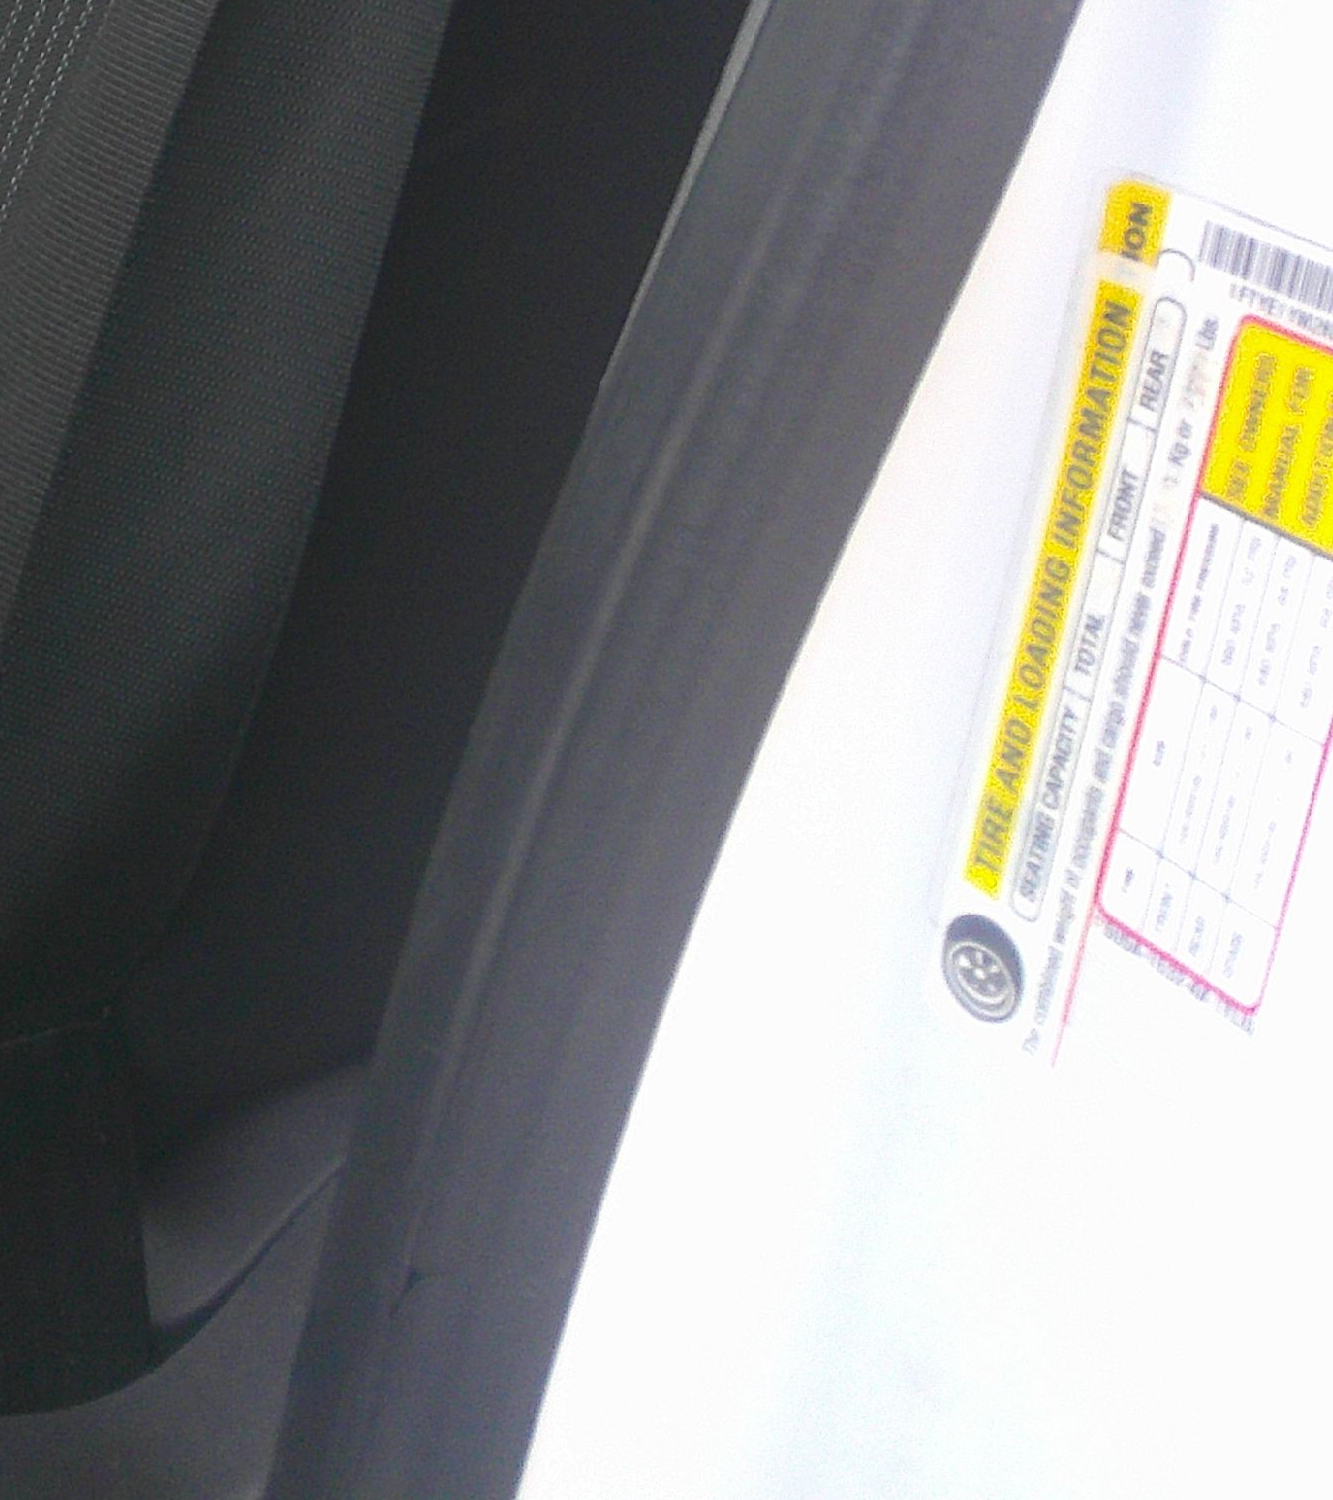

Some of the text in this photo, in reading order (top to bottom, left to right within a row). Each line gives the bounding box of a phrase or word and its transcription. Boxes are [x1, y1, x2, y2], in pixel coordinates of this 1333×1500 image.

[975, 300, 1134, 873] TIRE AND LOADING INFORMATION
[1019, 349, 1169, 904] SEATING CAPACITY TOTAL FRONT REAR
[1167, 442, 1193, 468] Kg
